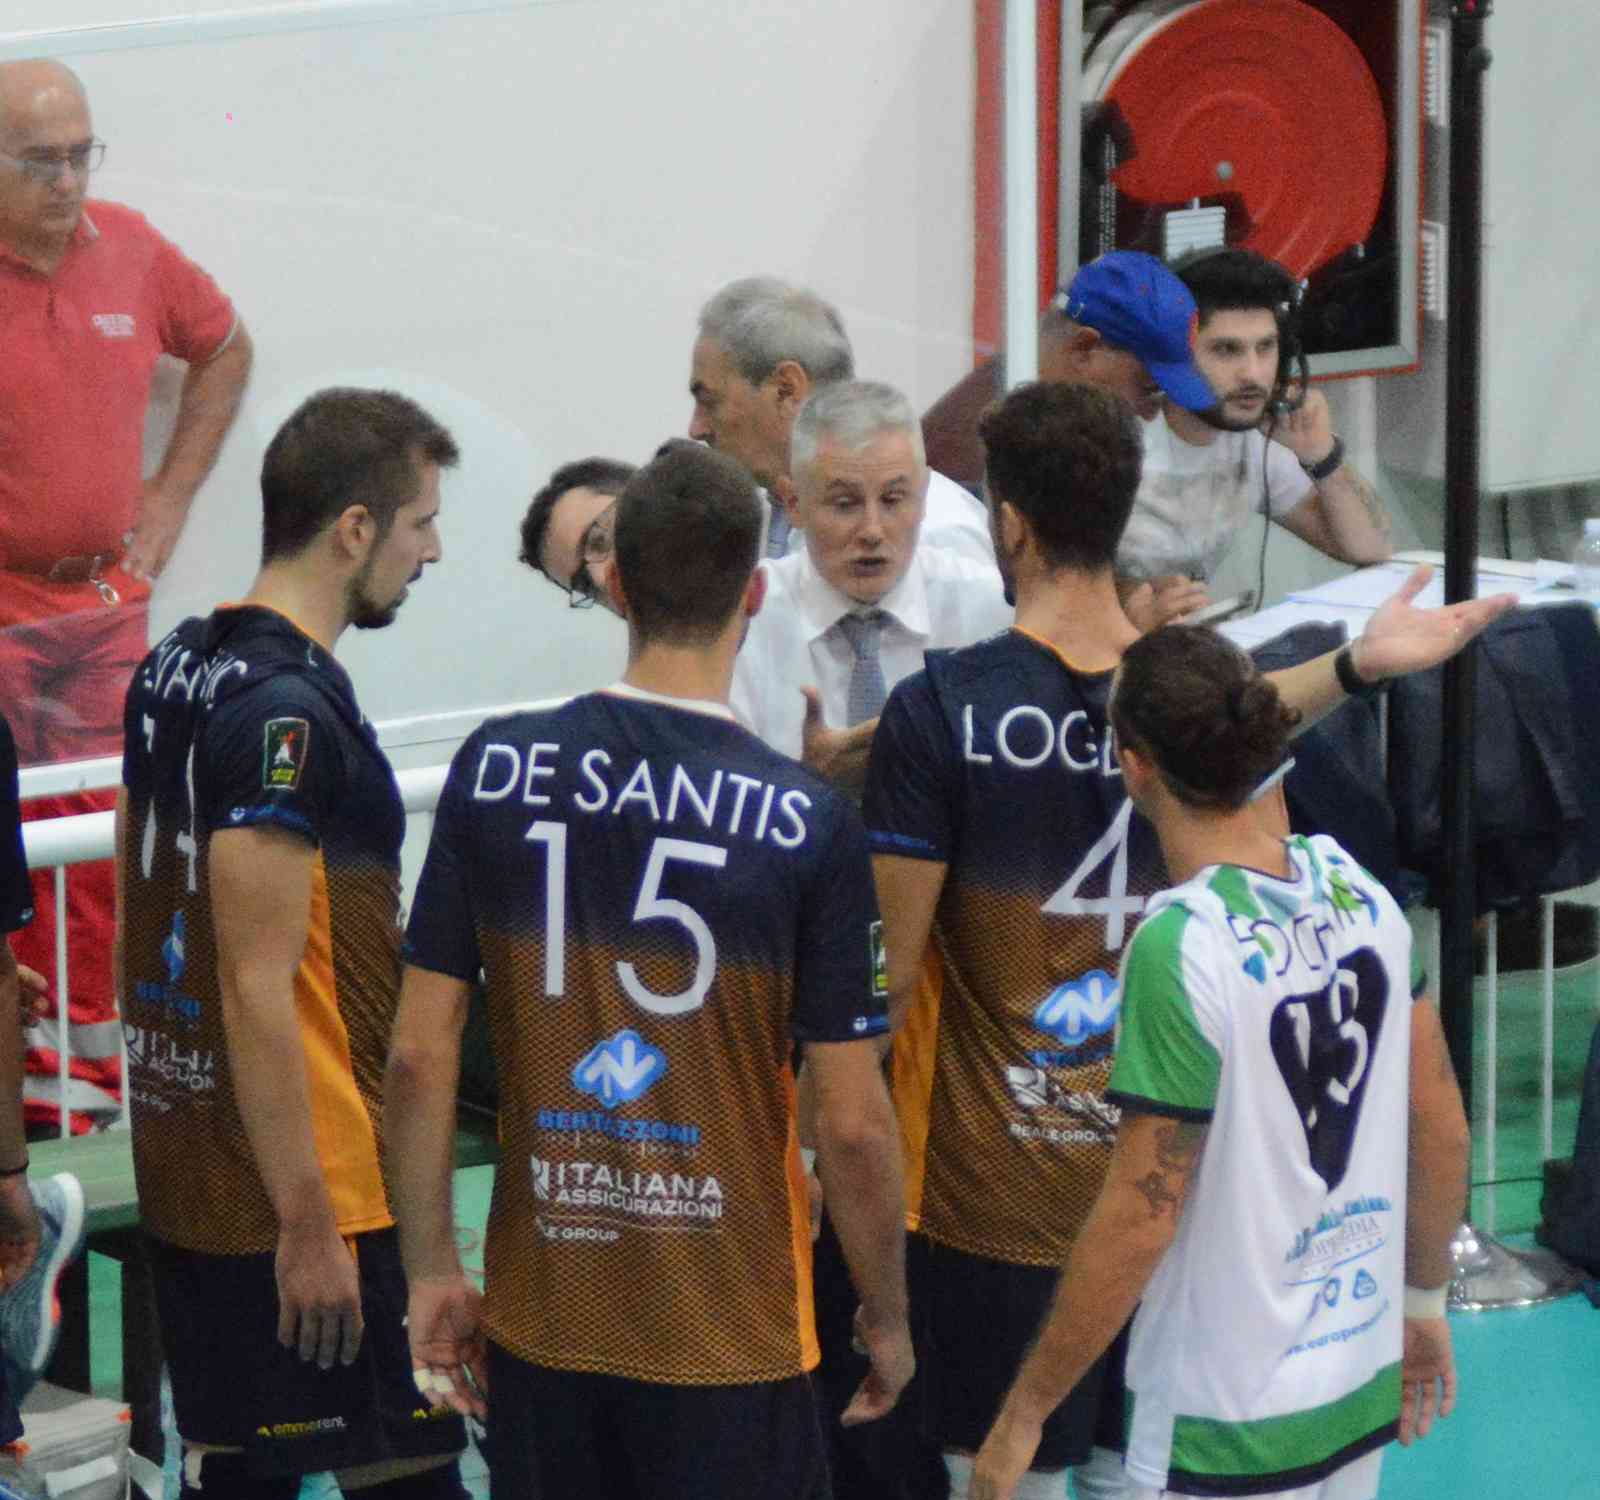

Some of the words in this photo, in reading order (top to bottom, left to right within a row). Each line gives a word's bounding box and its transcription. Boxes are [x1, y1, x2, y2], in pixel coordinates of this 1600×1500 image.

[473, 742, 561, 805] DE
[574, 749, 813, 848] SANTIS
[1040, 796, 1146, 952] 4
[525, 820, 729, 1016] 15
[555, 1187, 723, 1219] ASSICURAZIONI
[557, 1161, 723, 1200] ITALIANA
[561, 1226, 620, 1242] GROUP
